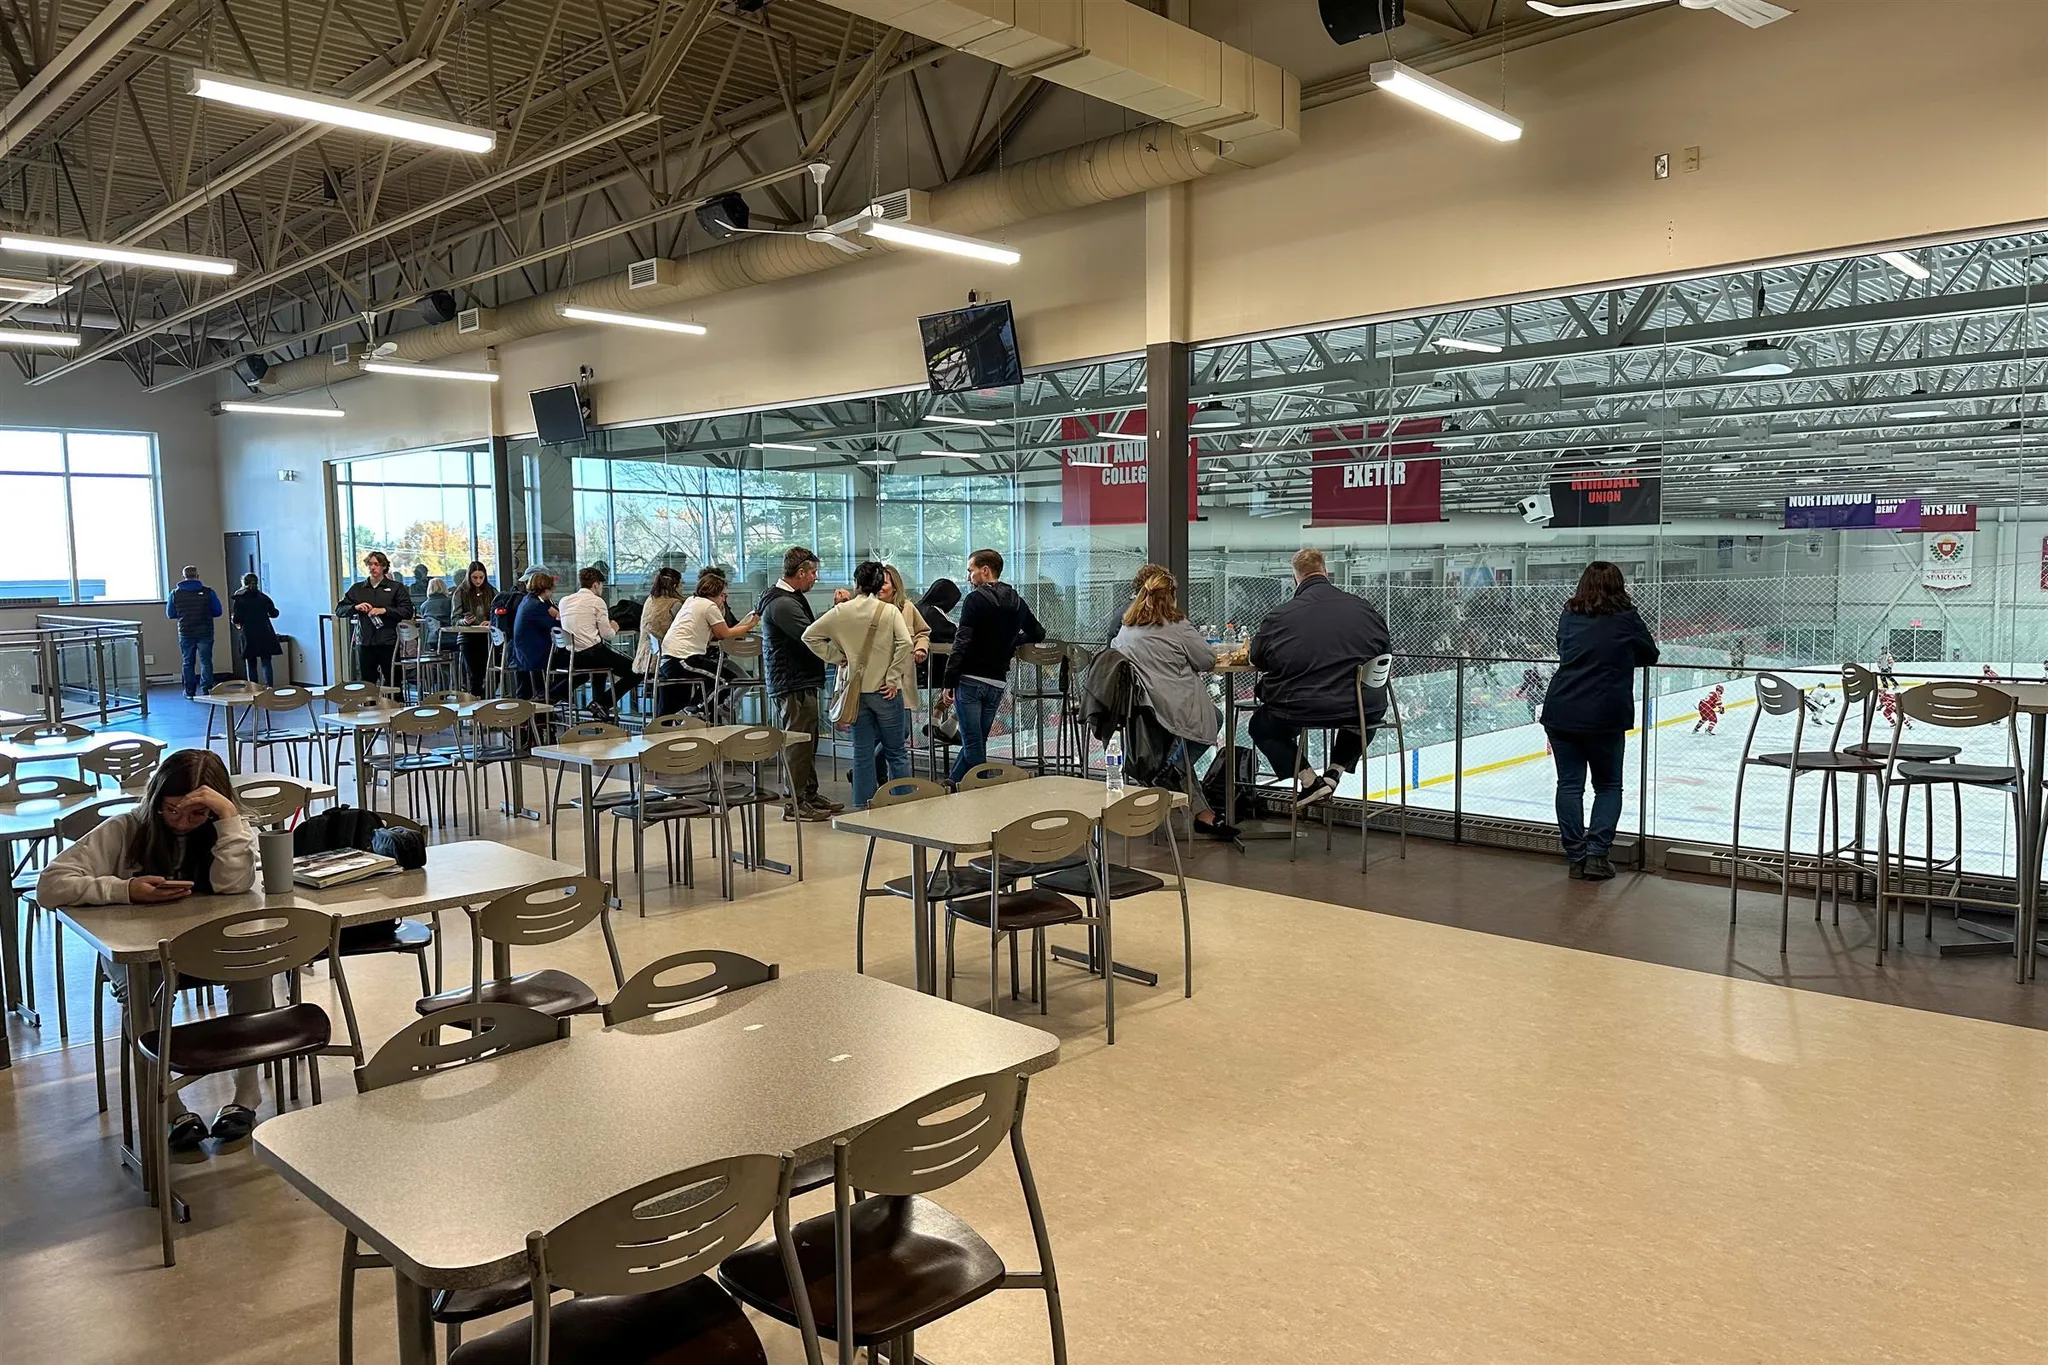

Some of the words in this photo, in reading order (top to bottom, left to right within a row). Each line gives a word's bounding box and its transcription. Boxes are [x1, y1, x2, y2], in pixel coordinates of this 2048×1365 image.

[1067, 443, 1111, 467] SAINT
[1102, 465, 1147, 486] COLLEG
[1343, 462, 1406, 488] EXETER
[1588, 491, 1621, 504] UNION
[1789, 494, 1872, 507] NORTHWOOD
[1875, 505, 1898, 514] DEMY
[1920, 504, 1944, 516] ENTS
[1945, 504, 1968, 515] HILL
